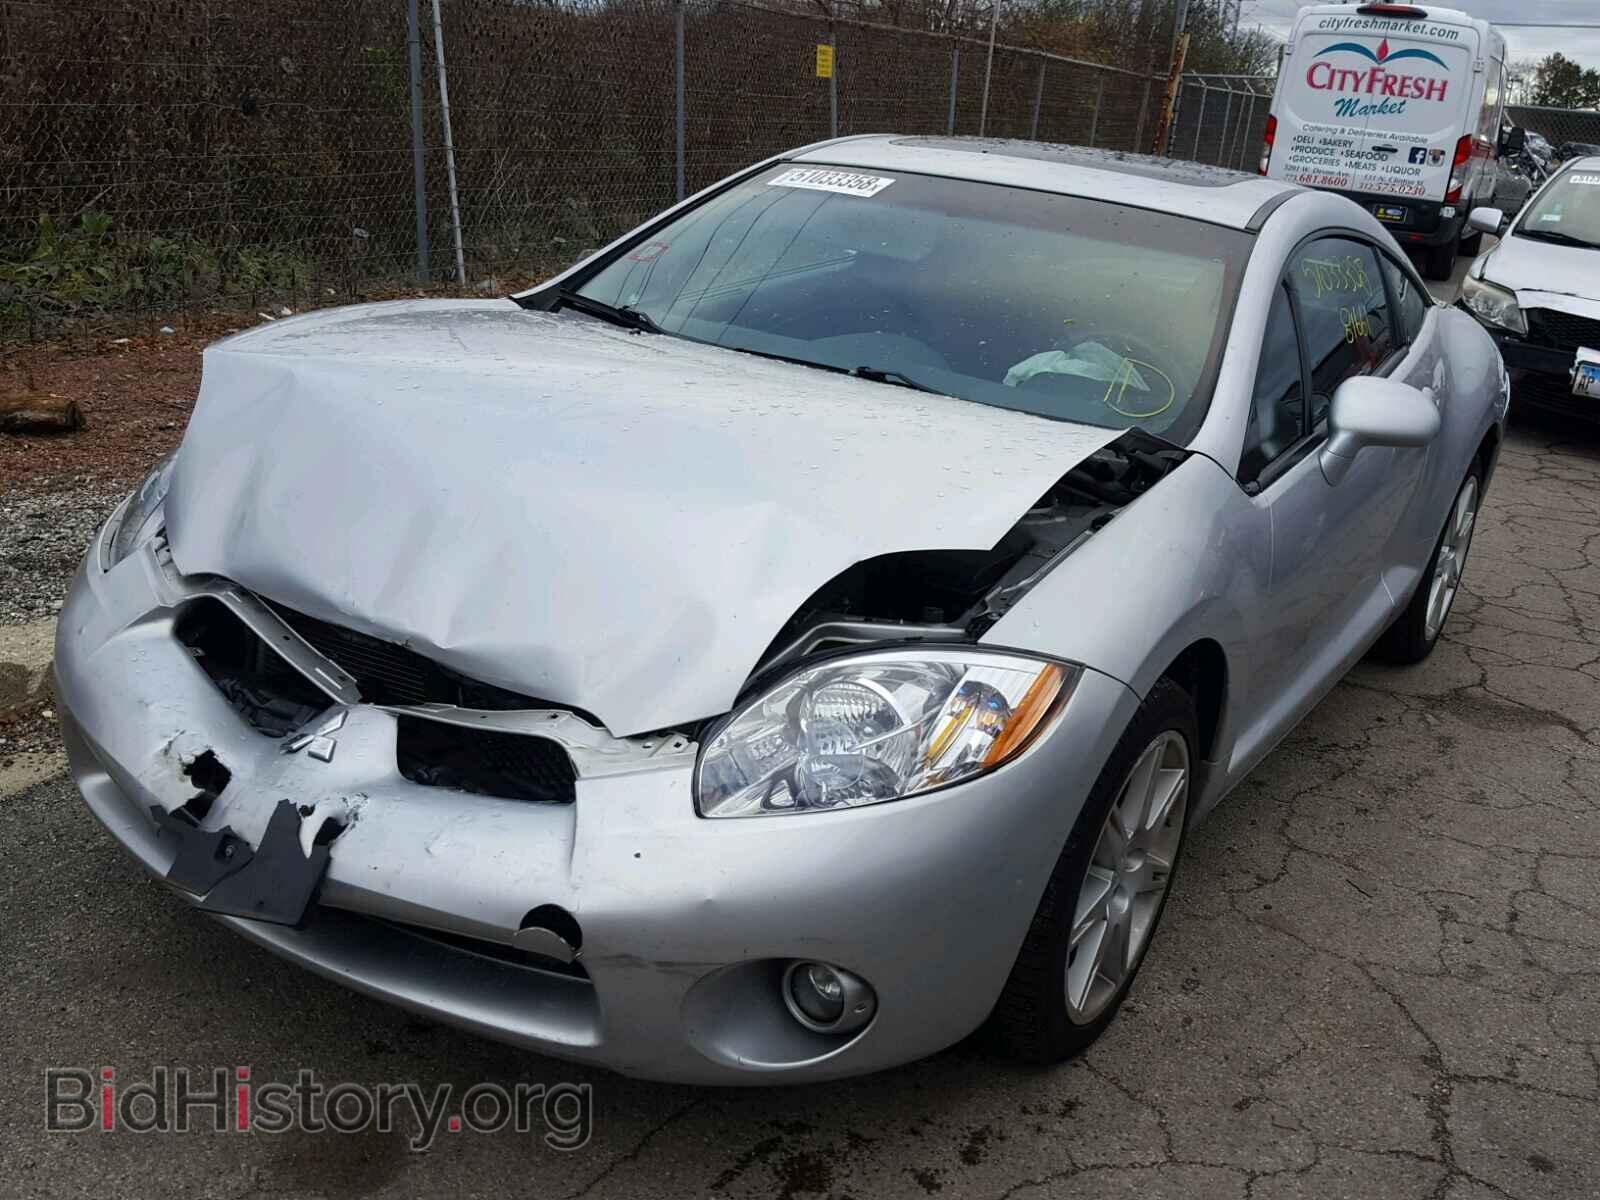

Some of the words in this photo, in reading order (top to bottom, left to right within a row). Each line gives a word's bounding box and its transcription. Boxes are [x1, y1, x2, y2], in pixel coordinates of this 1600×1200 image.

[1318, 17, 1460, 41] cityfreshmarket.com
[1334, 96, 1407, 118] Market
[1302, 123, 1337, 135] Catering
[1347, 128, 1387, 140] Deliveries
[1388, 133, 1429, 144] Available
